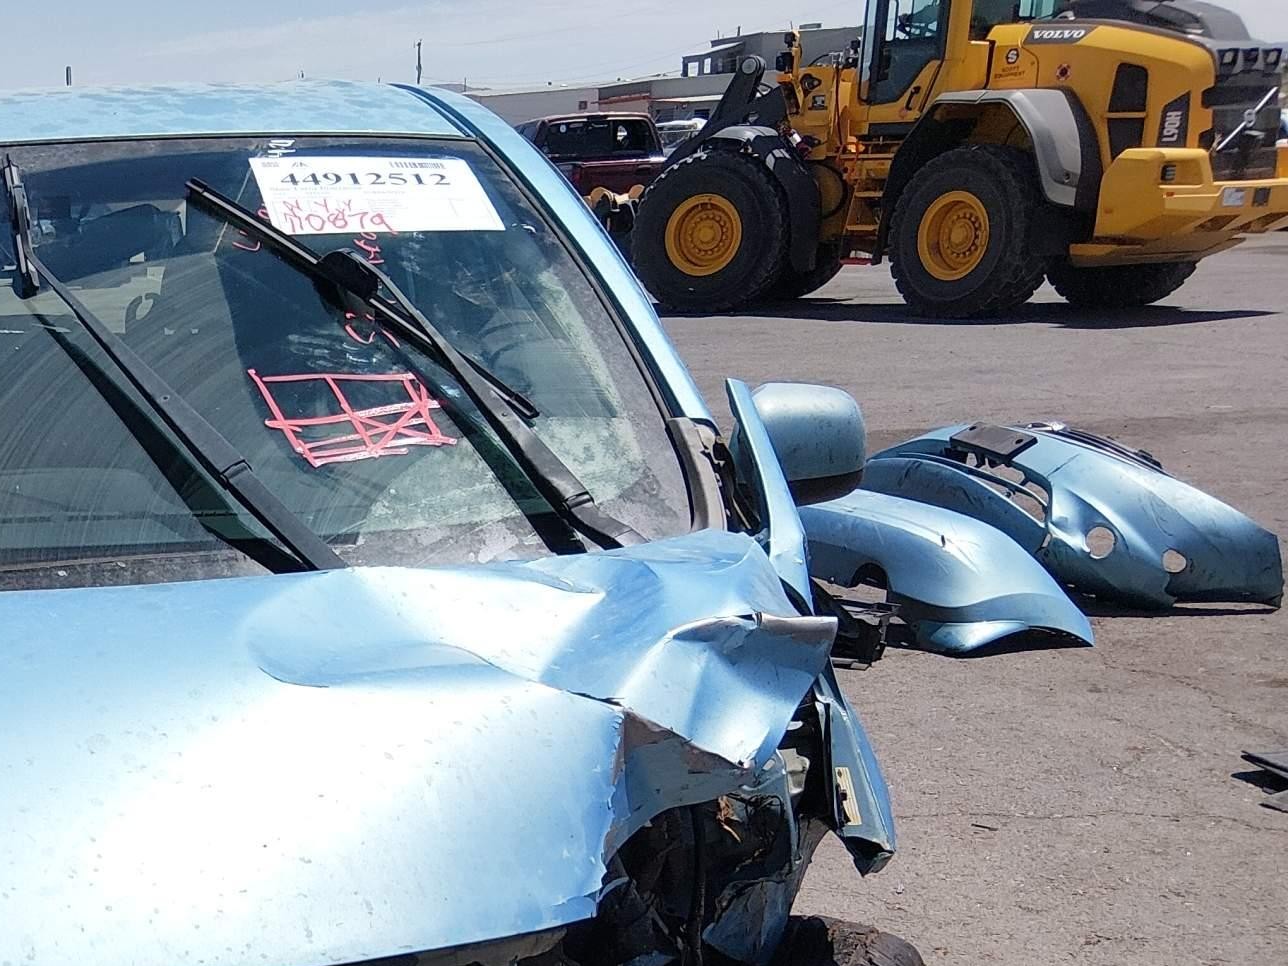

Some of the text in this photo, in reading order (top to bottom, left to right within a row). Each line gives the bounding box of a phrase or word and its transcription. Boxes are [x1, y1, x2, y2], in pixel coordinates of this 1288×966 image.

[1033, 30, 1085, 39] VOLVO
[1161, 110, 1182, 142] L90H
[280, 172, 451, 187] 44912512
